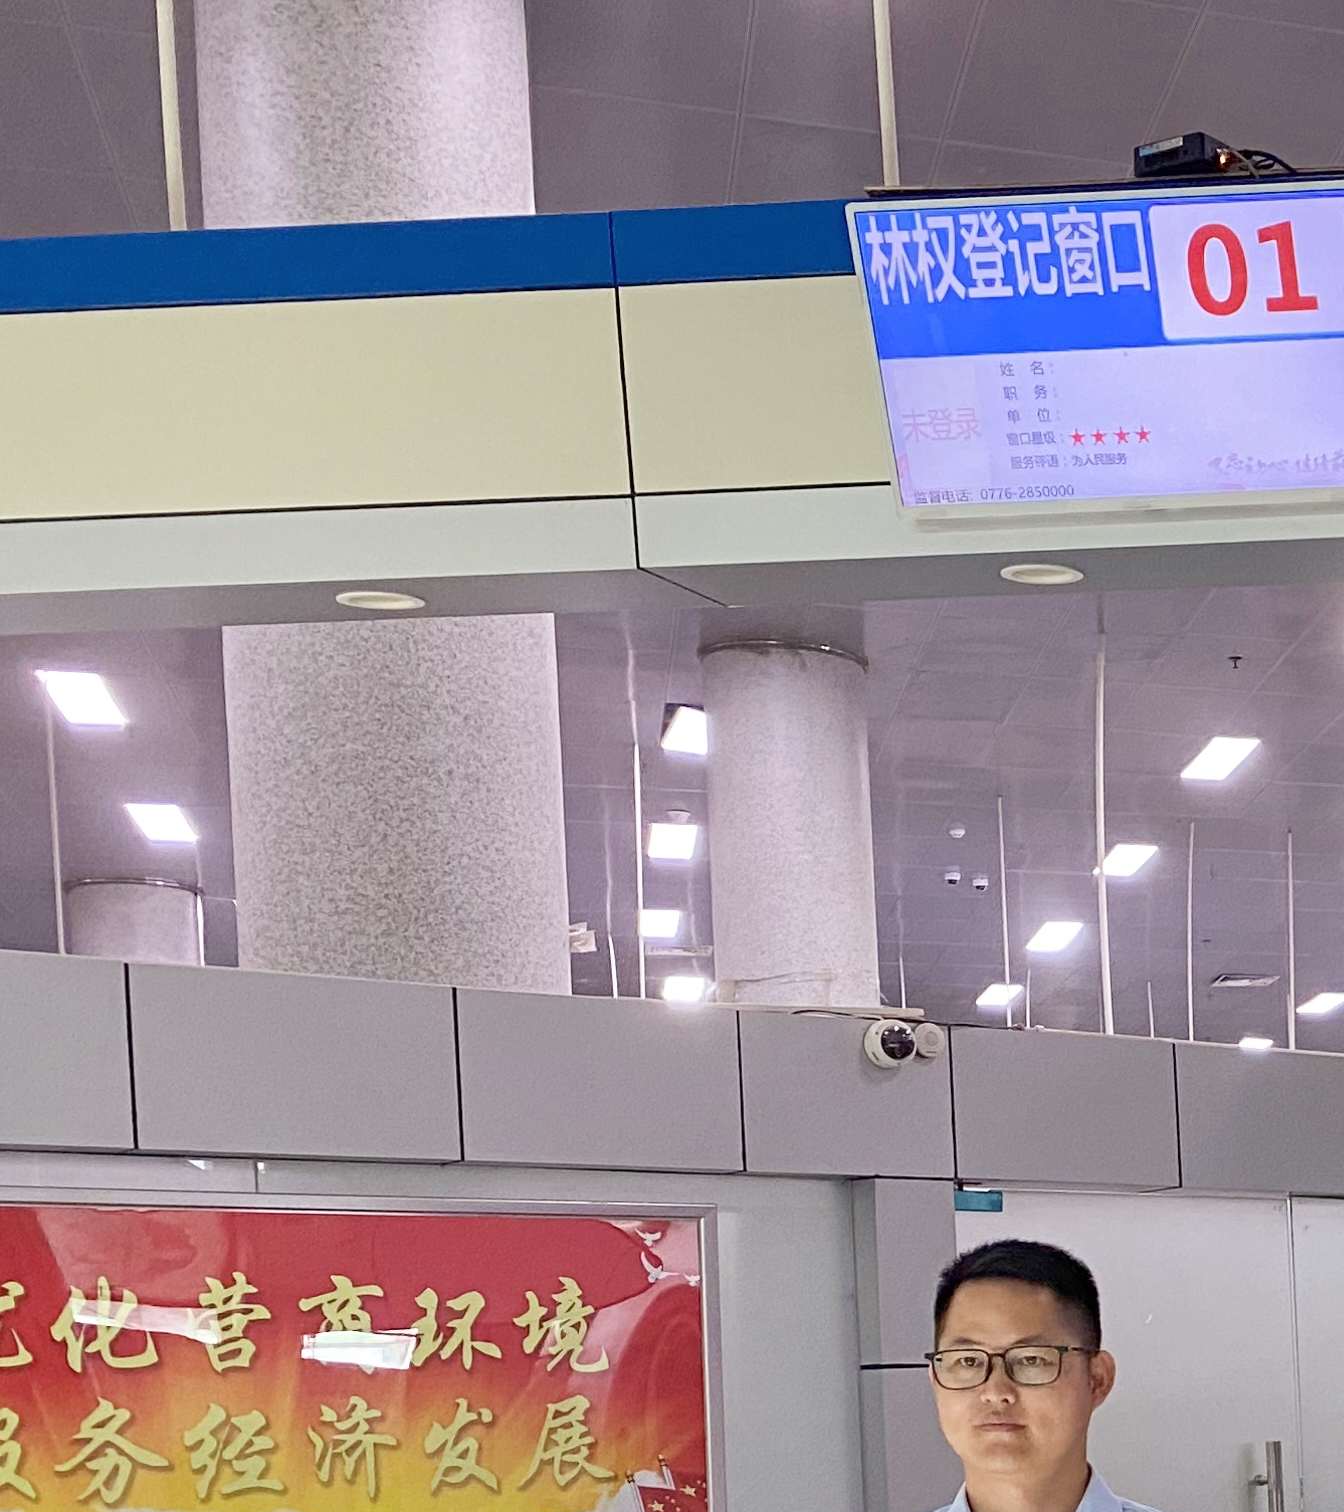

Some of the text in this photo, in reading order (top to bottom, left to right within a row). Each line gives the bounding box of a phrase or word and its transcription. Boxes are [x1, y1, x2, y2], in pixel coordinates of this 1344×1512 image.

[863, 206, 1153, 306] 林权登记窗口
[1186, 219, 1320, 318] 01
[901, 406, 983, 445] 未登录
[979, 484, 1076, 501] 0776-2850000
